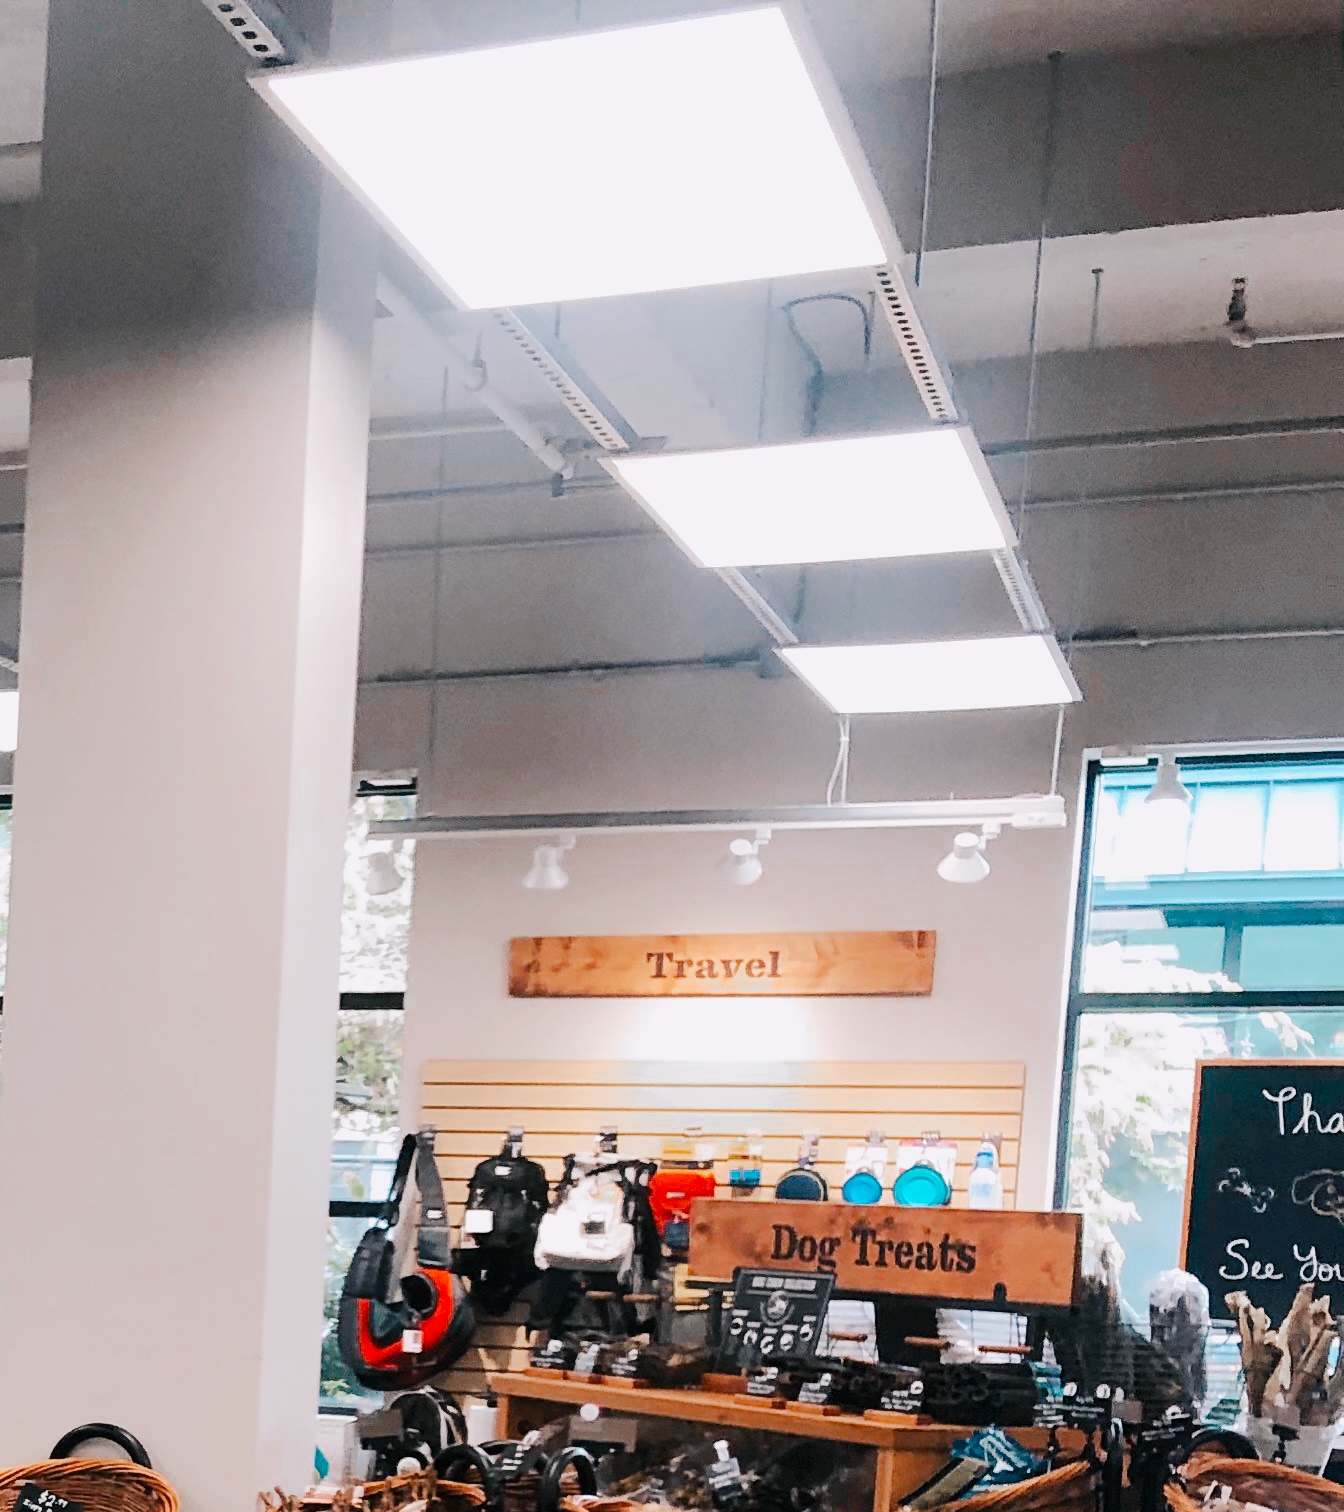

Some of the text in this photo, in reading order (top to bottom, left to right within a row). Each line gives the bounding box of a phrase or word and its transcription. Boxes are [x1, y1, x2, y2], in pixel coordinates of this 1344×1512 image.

[646, 951, 782, 979] Travel
[771, 1223, 977, 1274] Dog Treats
[1219, 1238, 1284, 1280] See
